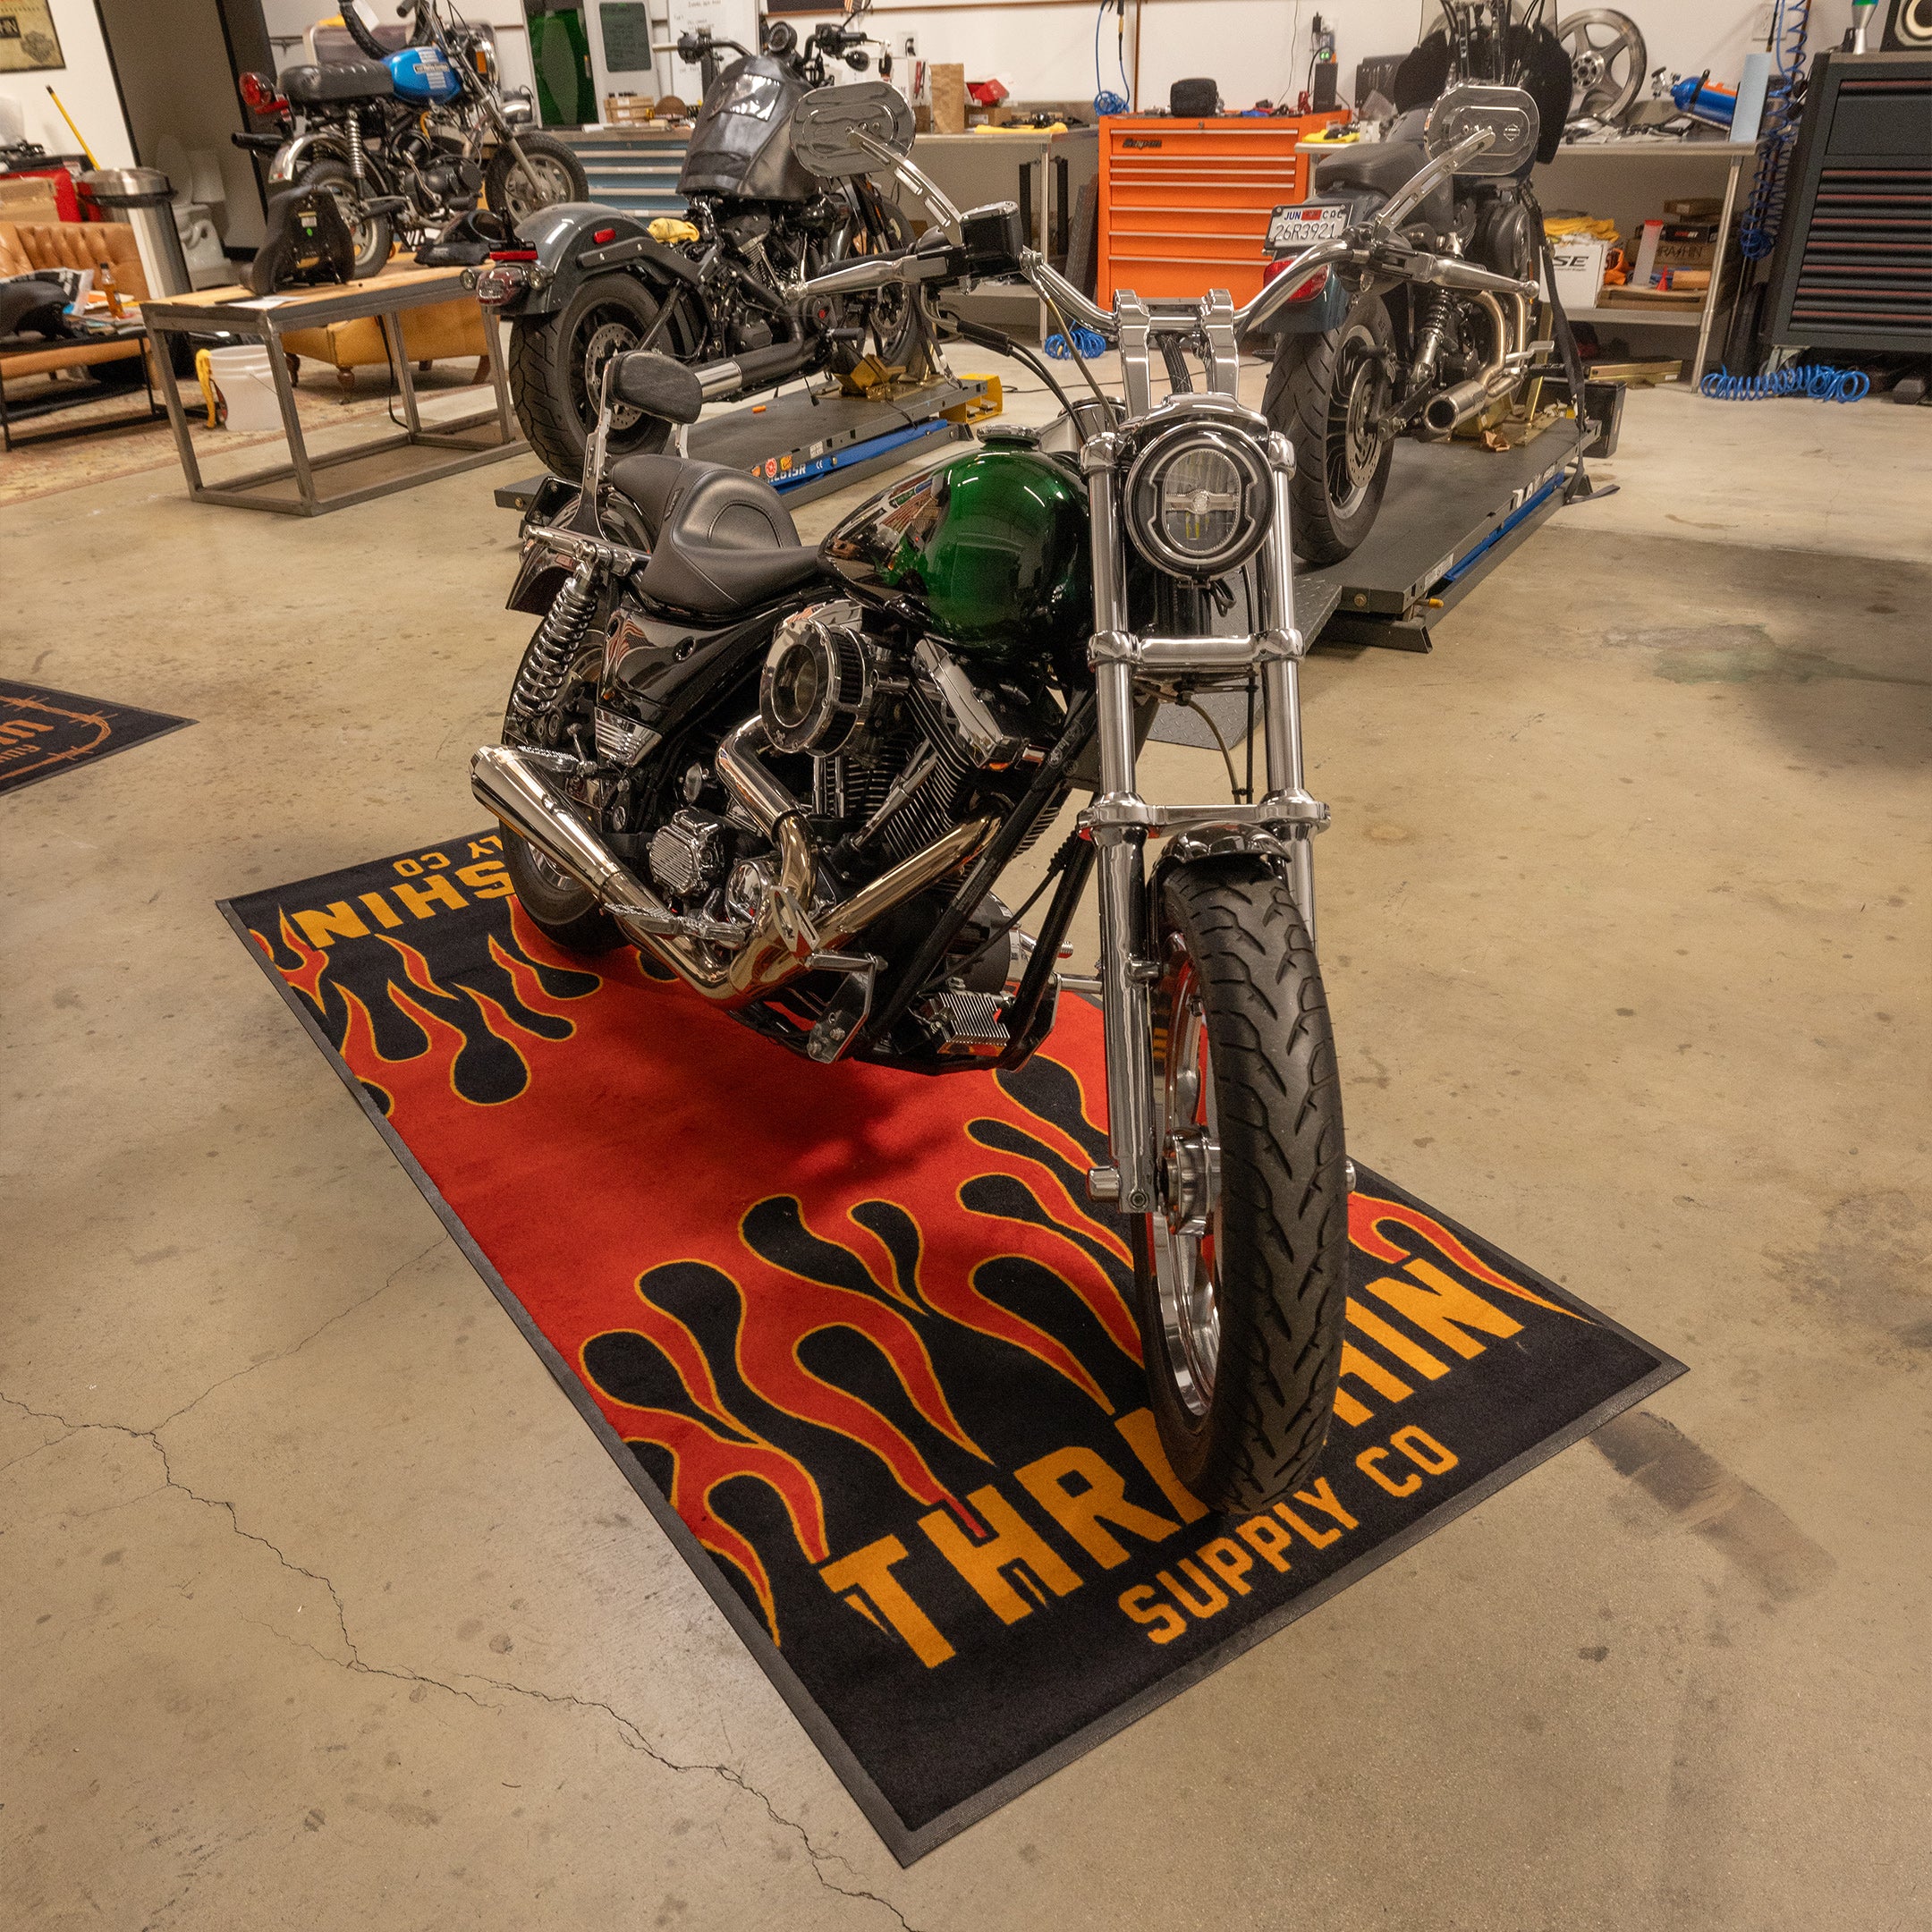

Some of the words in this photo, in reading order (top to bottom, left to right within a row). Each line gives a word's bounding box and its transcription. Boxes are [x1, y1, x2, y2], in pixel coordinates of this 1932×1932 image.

[1284, 211, 1301, 220] JUN
[1275, 223, 1335, 240] 26R3921
[1553, 256, 1589, 267] SE
[393, 852, 451, 877] CO
[291, 860, 516, 948] SHIN
[818, 1258, 1524, 1668] THRIN
[1118, 1477, 1360, 1644] SUPPLY
[1356, 1425, 1459, 1497] CO
